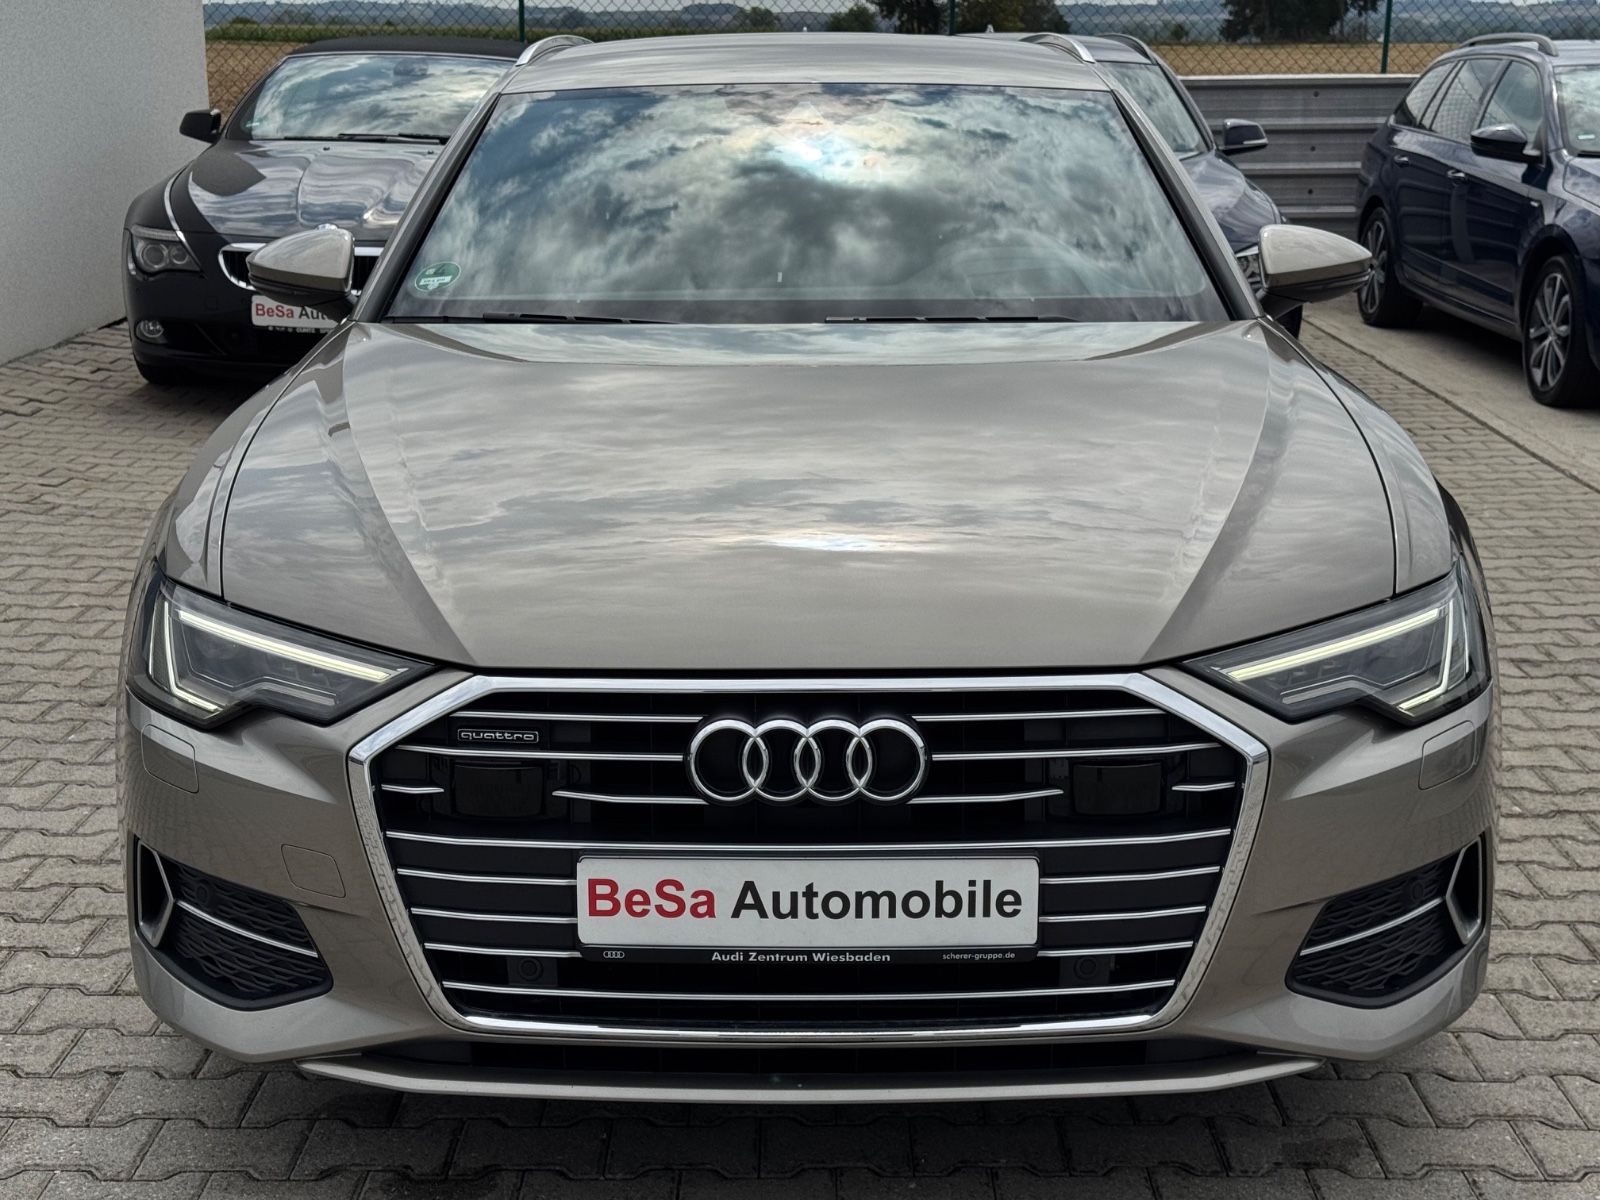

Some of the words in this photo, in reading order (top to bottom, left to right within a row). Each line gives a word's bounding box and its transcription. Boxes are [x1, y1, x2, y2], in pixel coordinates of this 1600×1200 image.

[255, 303, 295, 319] BeSa
[461, 732, 535, 740] quattro
[588, 878, 717, 919] BeSa
[731, 879, 1023, 920] Automobile
[711, 951, 744, 962] Audi
[749, 952, 808, 962] Zentrum
[812, 952, 891, 962] Wiesbaden
[942, 952, 1016, 960] scherer-gruppe.de
